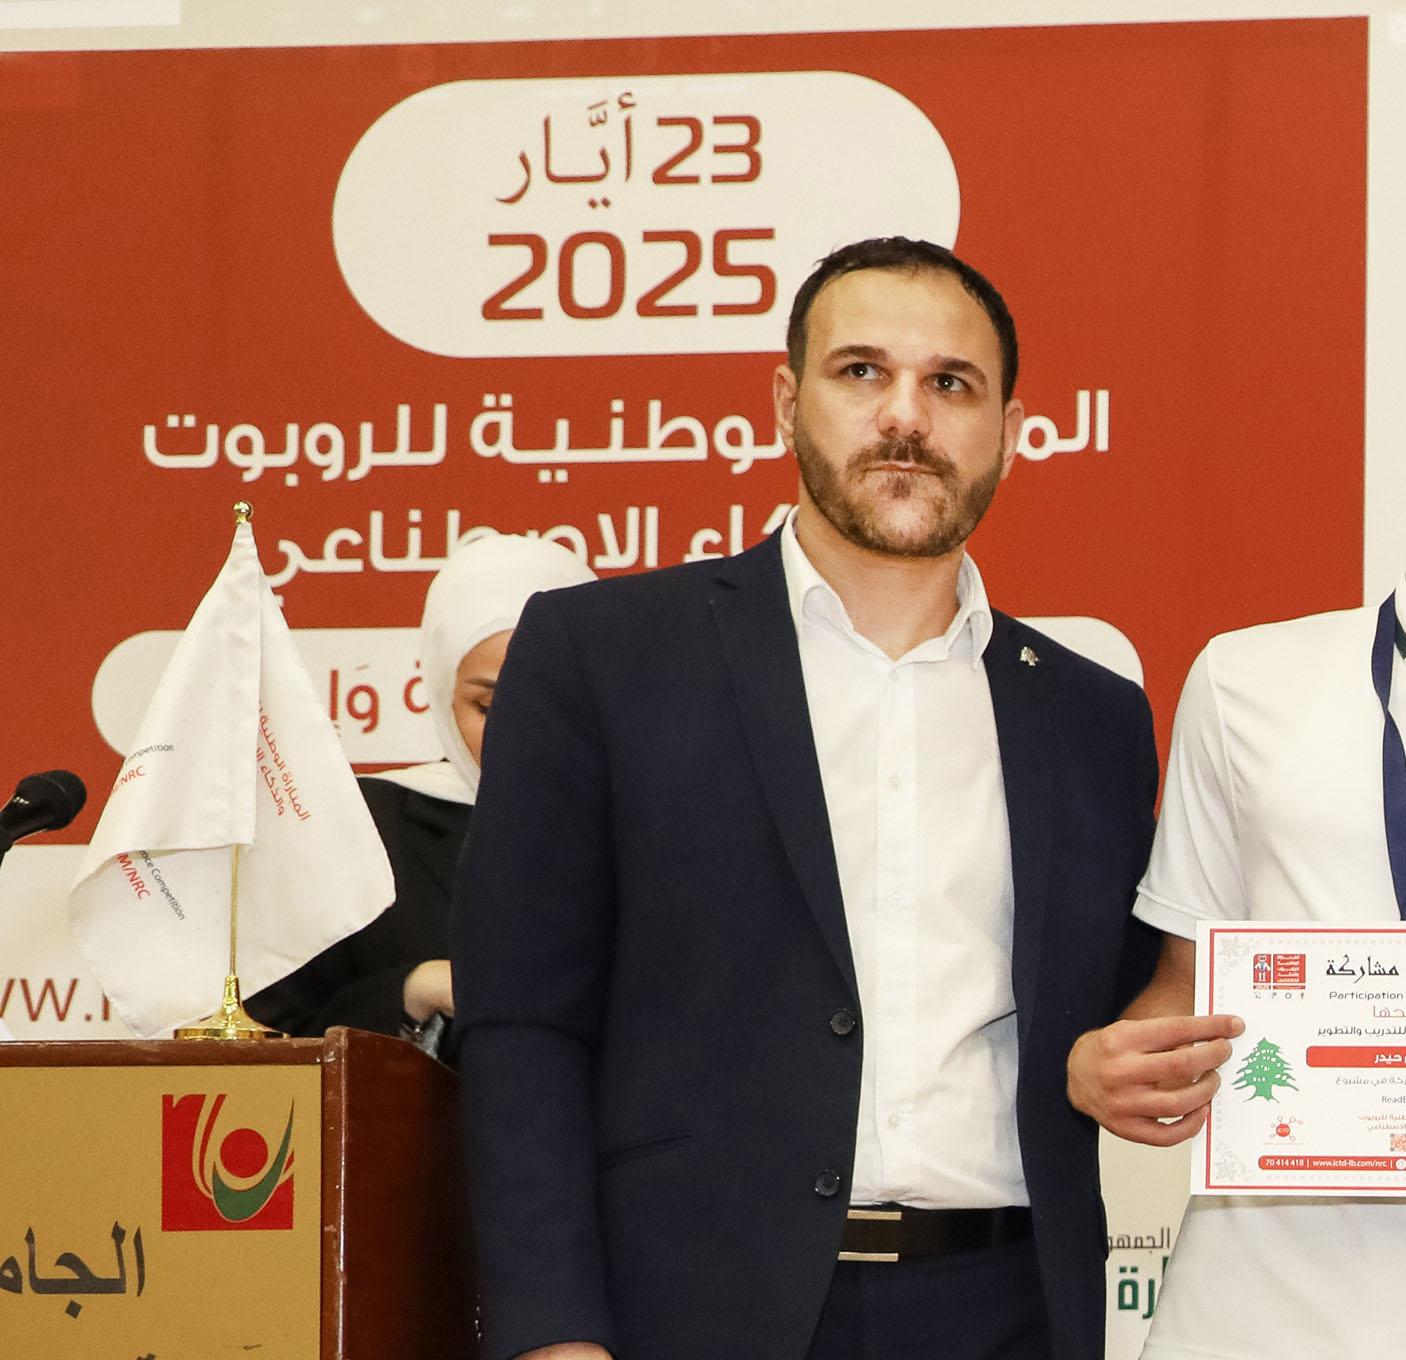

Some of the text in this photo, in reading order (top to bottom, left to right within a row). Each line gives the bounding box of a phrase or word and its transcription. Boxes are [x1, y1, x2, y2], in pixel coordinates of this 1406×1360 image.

[652, 114, 762, 184] 23
[481, 227, 777, 320] 2025
[143, 392, 787, 487] وطنية للروبوت
[125, 743, 175, 764] ompetition
[151, 868, 185, 921] Competition
[1329, 991, 1403, 1000] Participation
